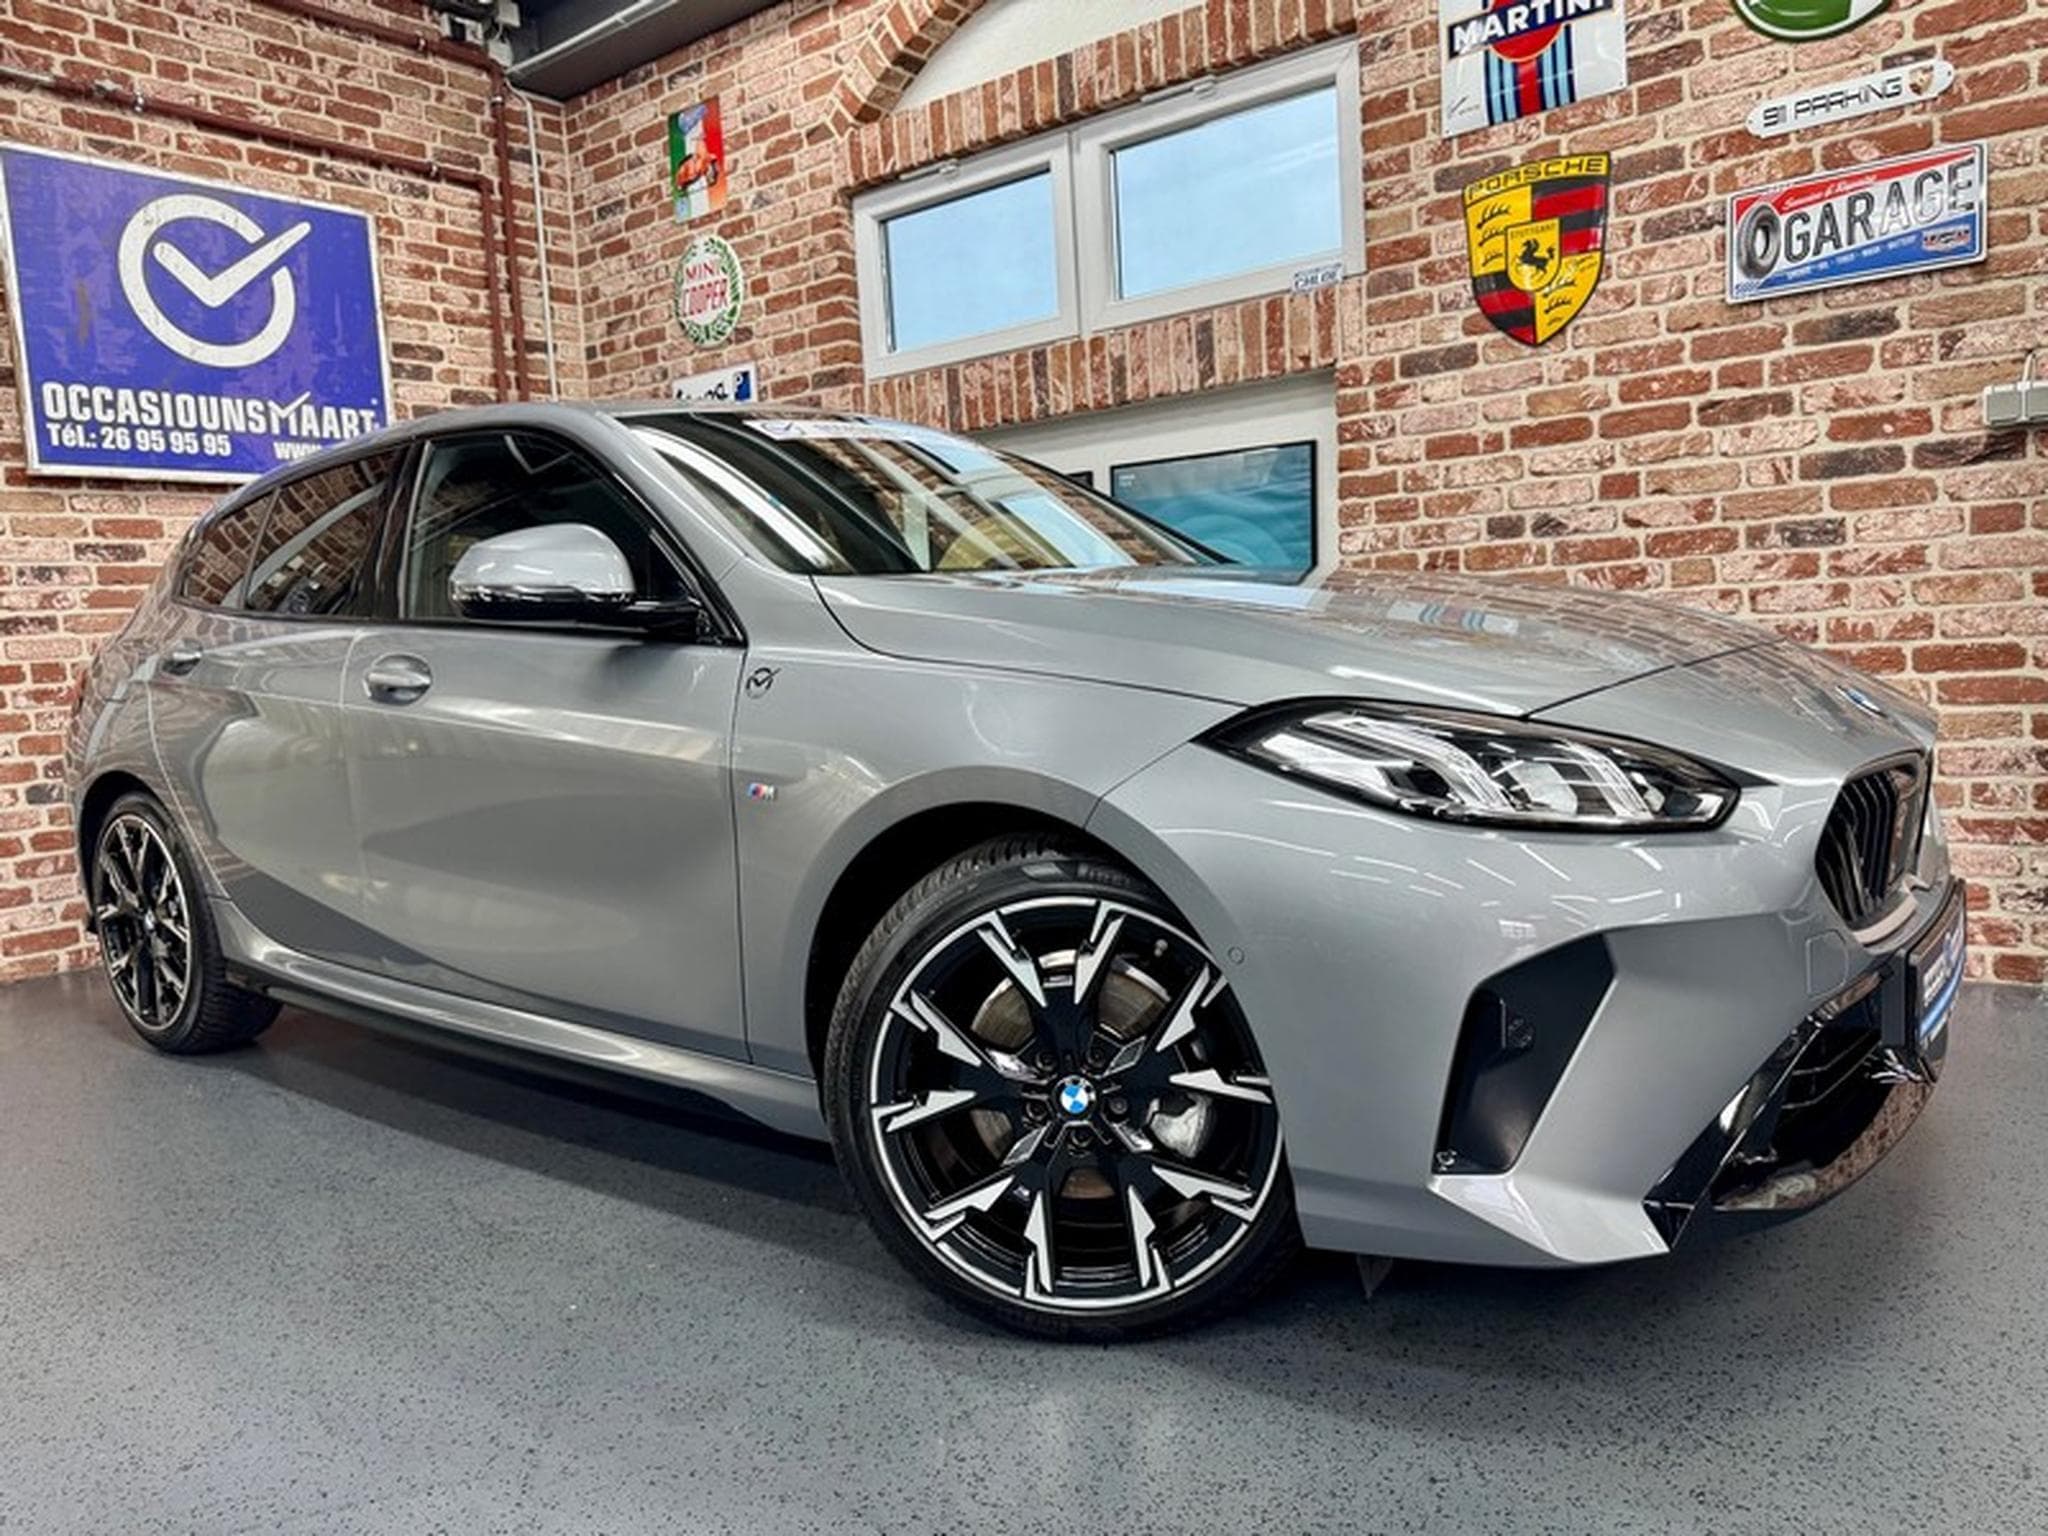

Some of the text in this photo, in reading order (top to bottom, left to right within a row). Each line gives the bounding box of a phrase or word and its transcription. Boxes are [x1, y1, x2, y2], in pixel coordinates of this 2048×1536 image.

[1453, 0, 1605, 54] MARTIN
[1794, 76, 1902, 119] PARKING
[1468, 157, 1604, 200] PORSCHE
[1783, 156, 1975, 263] GARAGE
[686, 260, 721, 284] MINI
[682, 278, 728, 317] COOPER
[46, 422, 232, 457] Tél.: 26 95 95 95
